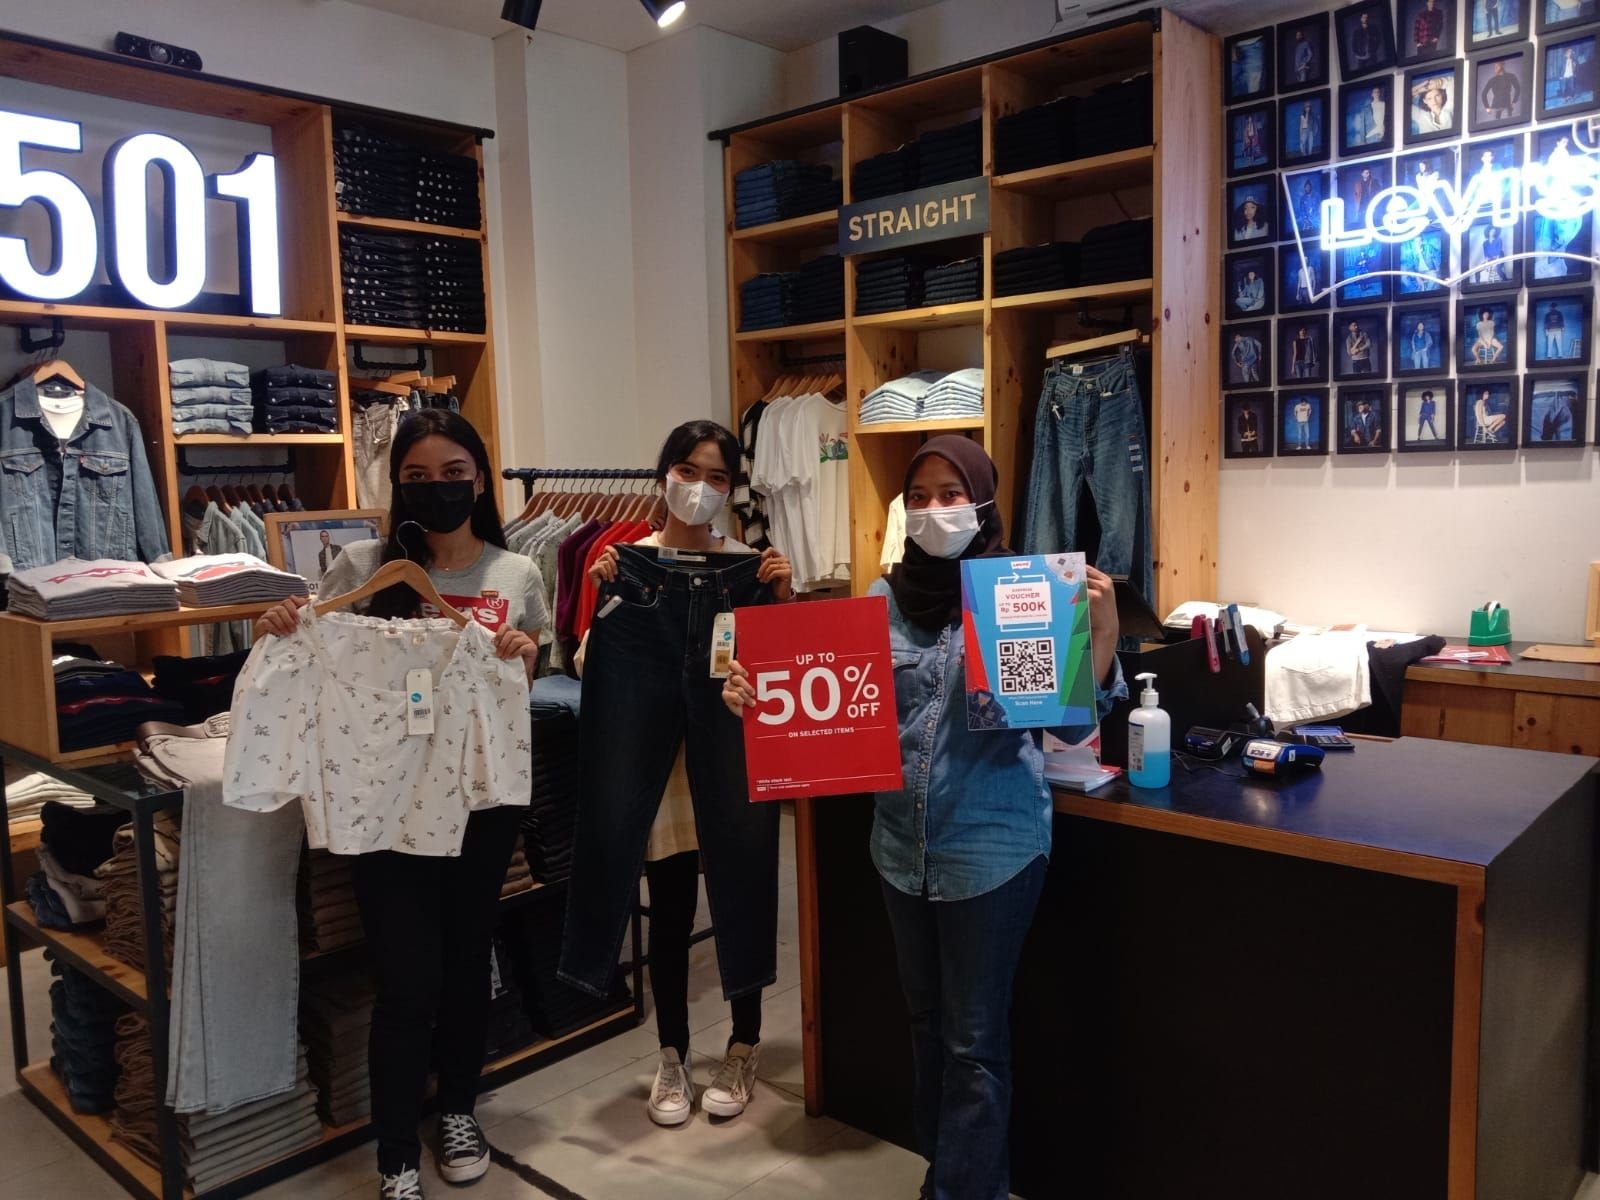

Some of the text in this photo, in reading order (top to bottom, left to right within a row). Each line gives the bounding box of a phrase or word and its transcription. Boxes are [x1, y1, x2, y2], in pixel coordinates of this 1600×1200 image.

[0, 111, 281, 315] 501
[849, 193, 977, 241] STRAIGHT
[1013, 601, 1046, 613] 500K
[795, 652, 835, 665] UP TO
[756, 662, 879, 726] 50%
[847, 702, 881, 718] OFF
[800, 728, 833, 737] SELECTED
[834, 726, 855, 734] ITEMS
